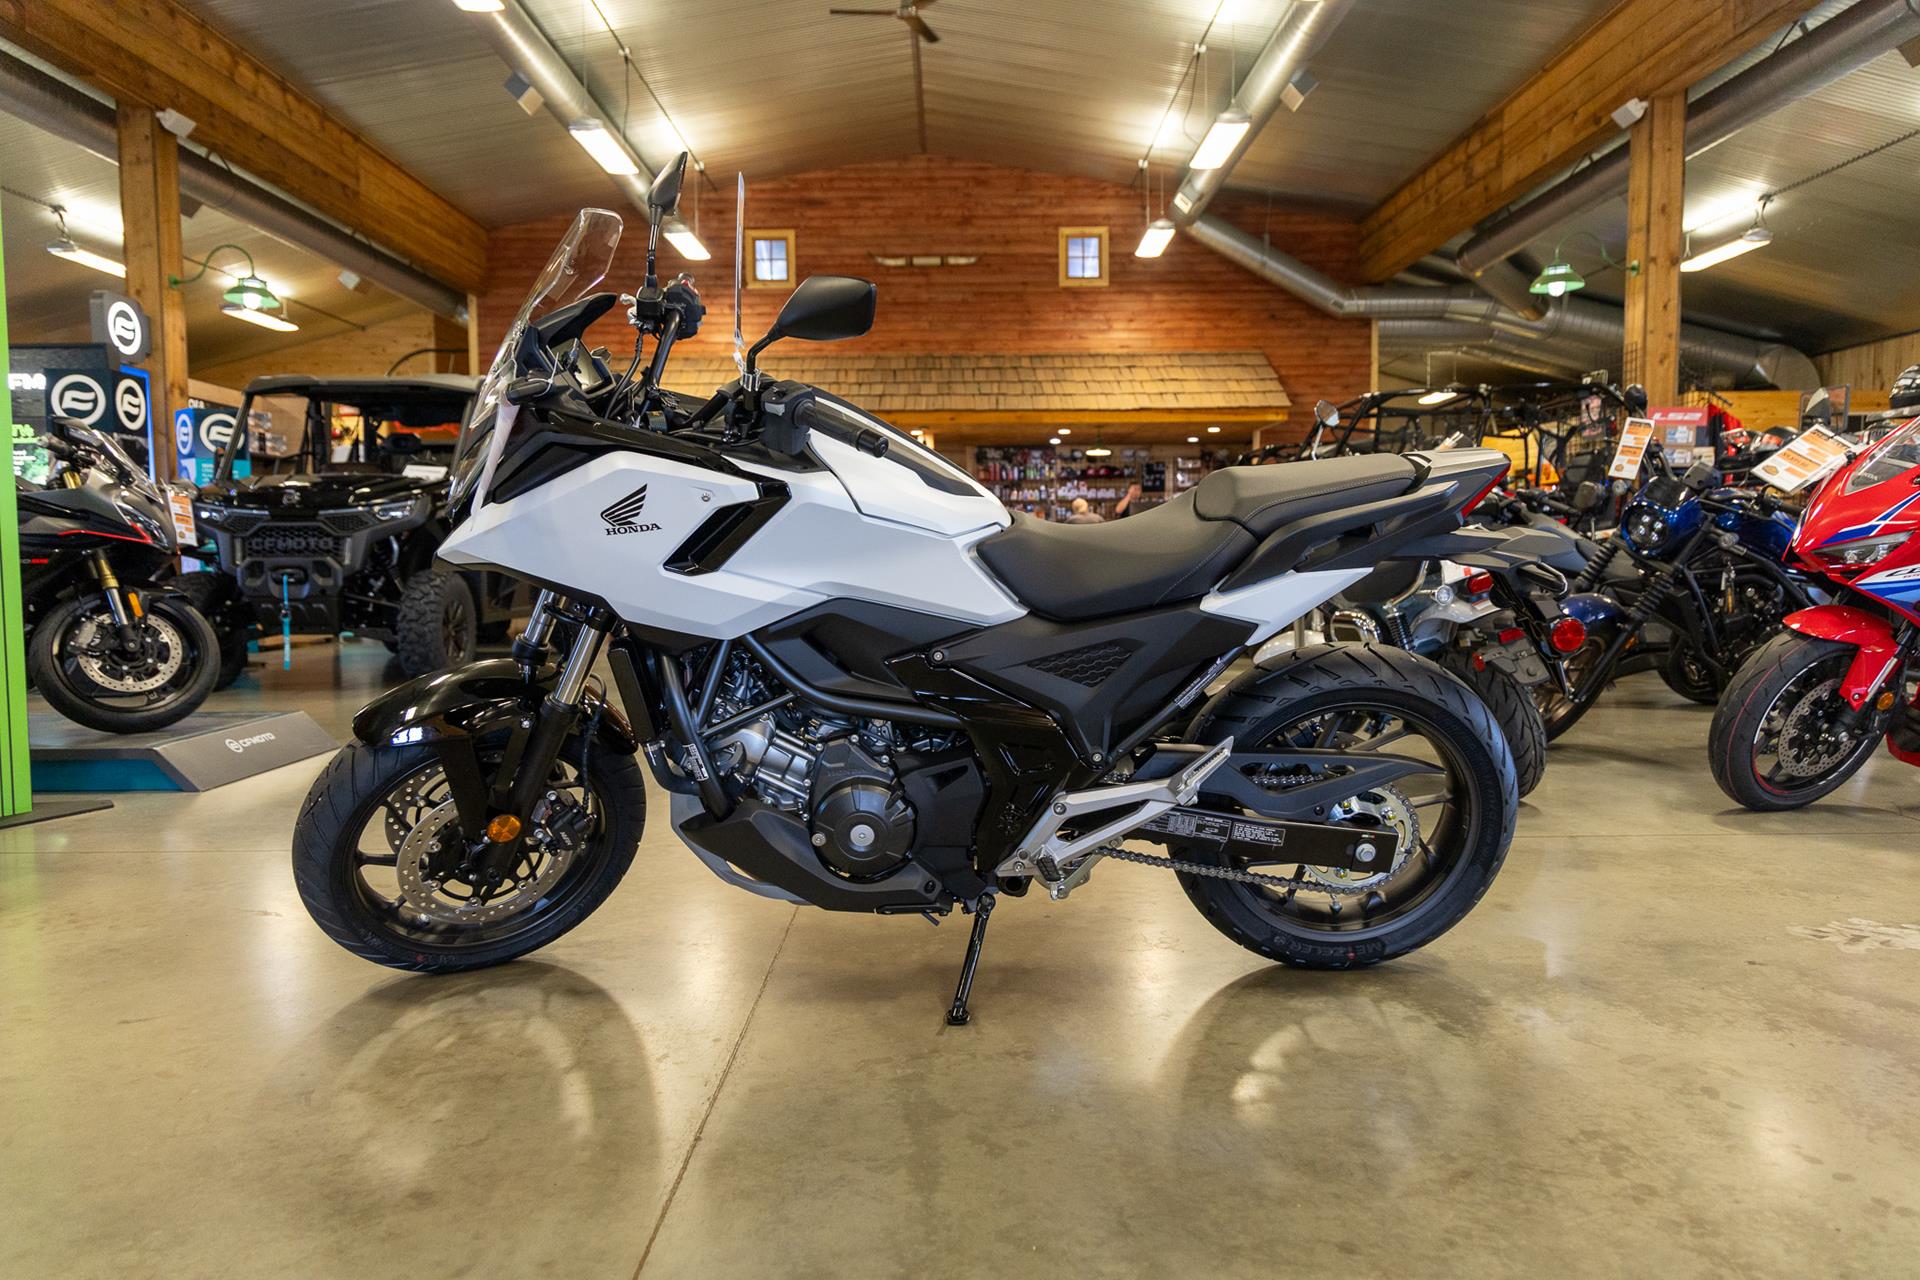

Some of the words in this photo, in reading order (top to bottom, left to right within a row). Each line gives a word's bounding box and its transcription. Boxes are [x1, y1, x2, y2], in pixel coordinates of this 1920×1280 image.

[605, 523, 663, 536] HONDA
[252, 537, 333, 550] CFMOTO
[238, 732, 276, 747] CFMOTO
